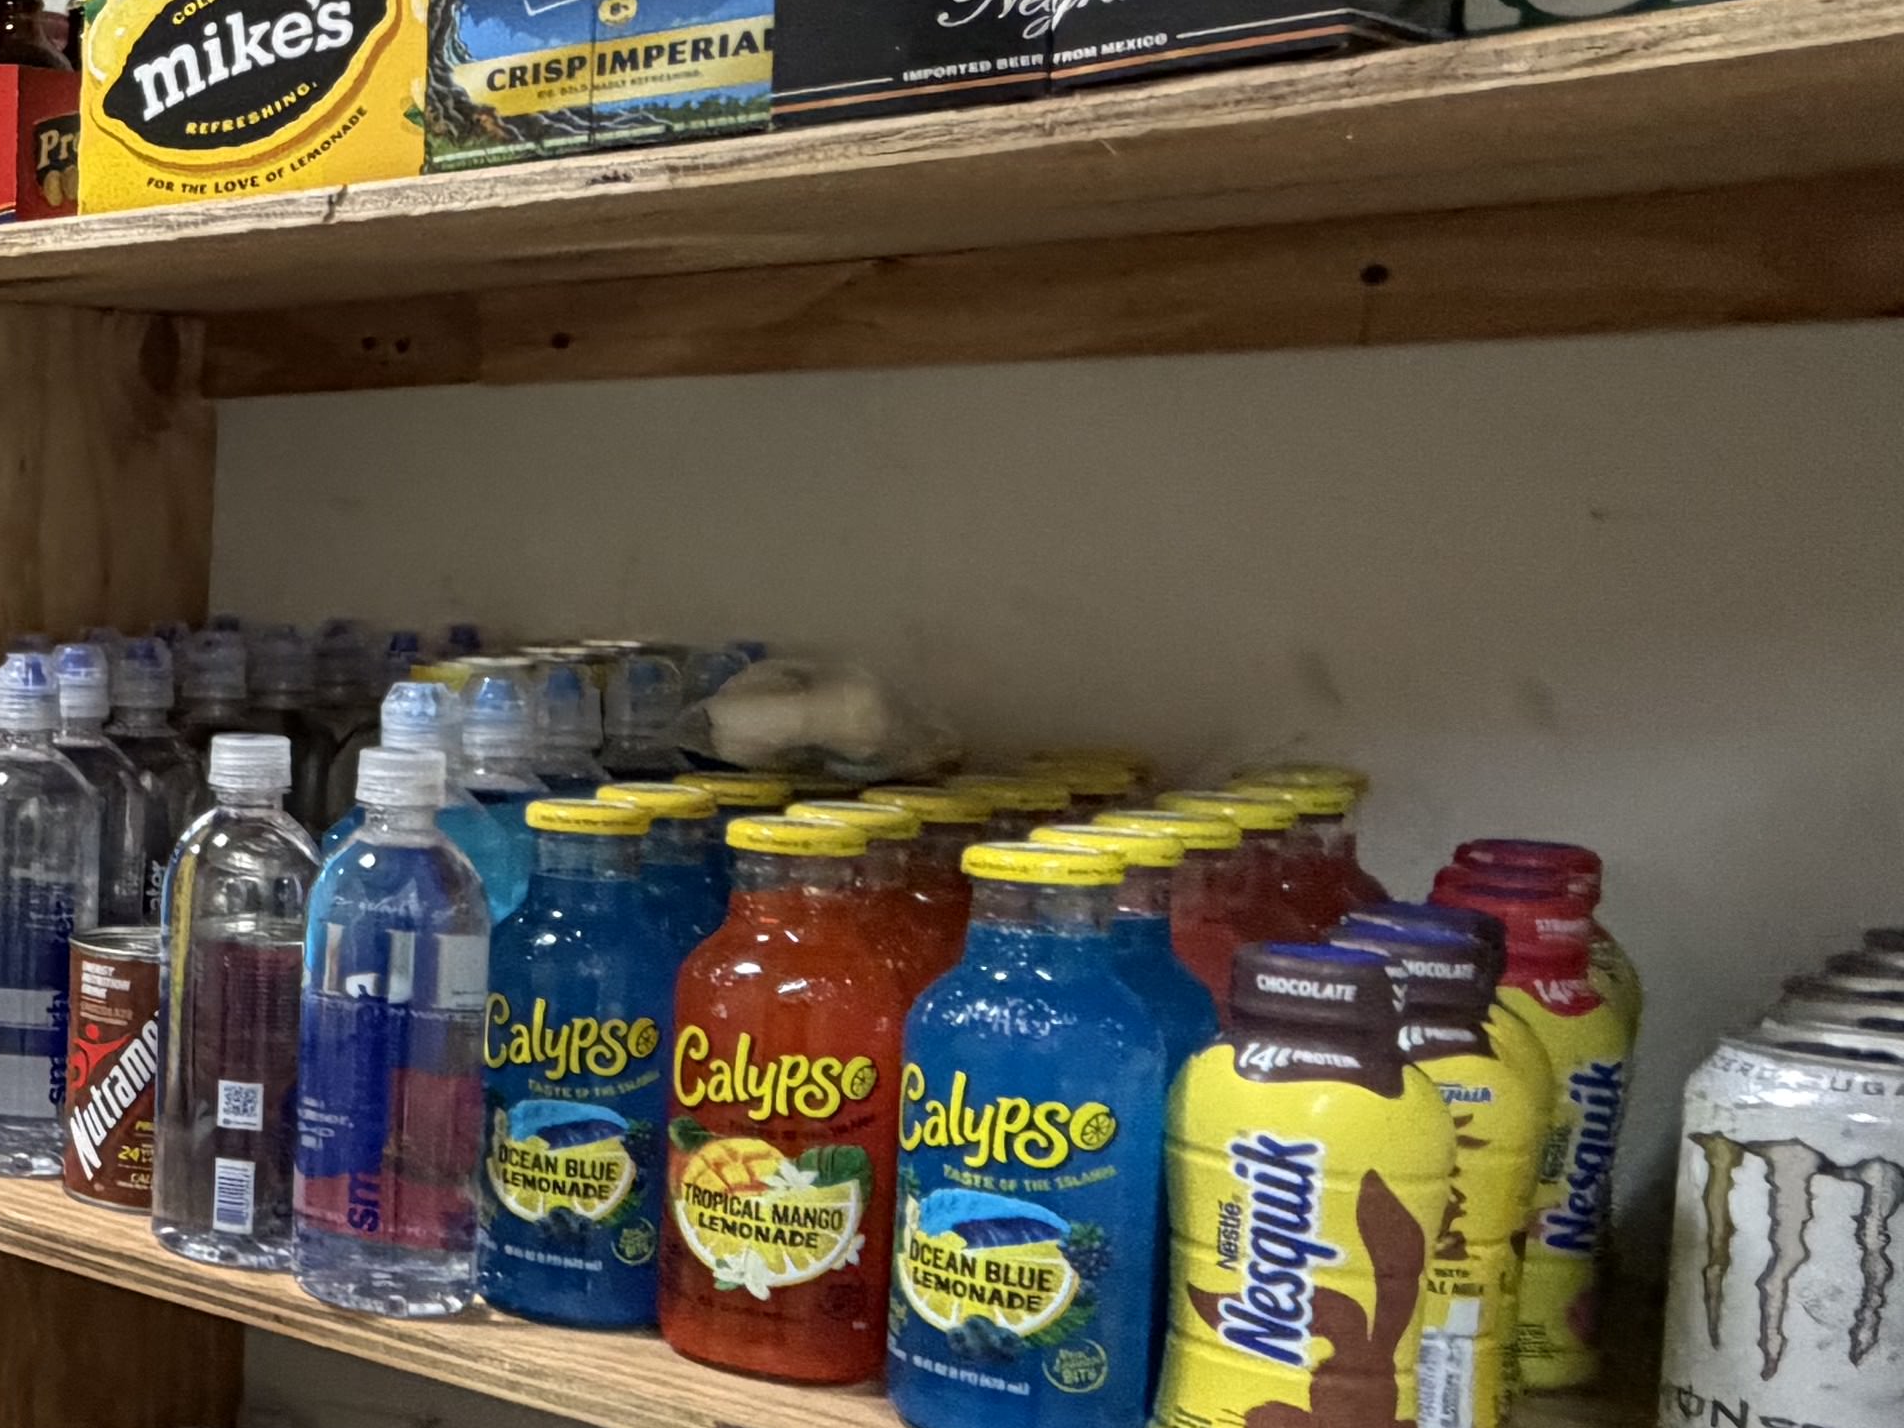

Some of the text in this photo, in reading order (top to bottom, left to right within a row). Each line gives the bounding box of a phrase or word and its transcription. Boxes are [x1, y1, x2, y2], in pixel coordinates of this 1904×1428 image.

[486, 55, 588, 92] CRISP
[903, 32, 1168, 83] IMPORTED BEER FROM MEXICO
[147, 105, 368, 195] FOR THE LOVE OF LEMONADE
[1256, 974, 1359, 1003] CHOCOLATE
[482, 992, 660, 1079] Calypso
[1293, 1046, 1361, 1070] PROTEIN
[673, 1023, 878, 1122] Calypso
[898, 1062, 1117, 1169] Calypso
[498, 1144, 619, 1182] OCEAN BLUE
[943, 1163, 996, 1189] TASTE
[999, 1178, 1018, 1192] OF
[1024, 1178, 1052, 1192] THE
[1543, 1058, 1625, 1256] Nesquik
[502, 1168, 610, 1201] LEMONADE
[683, 1183, 844, 1231] TROPICAL MANGO
[697, 1212, 820, 1249] LEMONADE
[1216, 1200, 1242, 1272] Nestlé
[1218, 1132, 1348, 1369] Nesquik
[909, 1239, 1055, 1292] OCEAN BLUE
[912, 1266, 1043, 1313] LEMONADE
